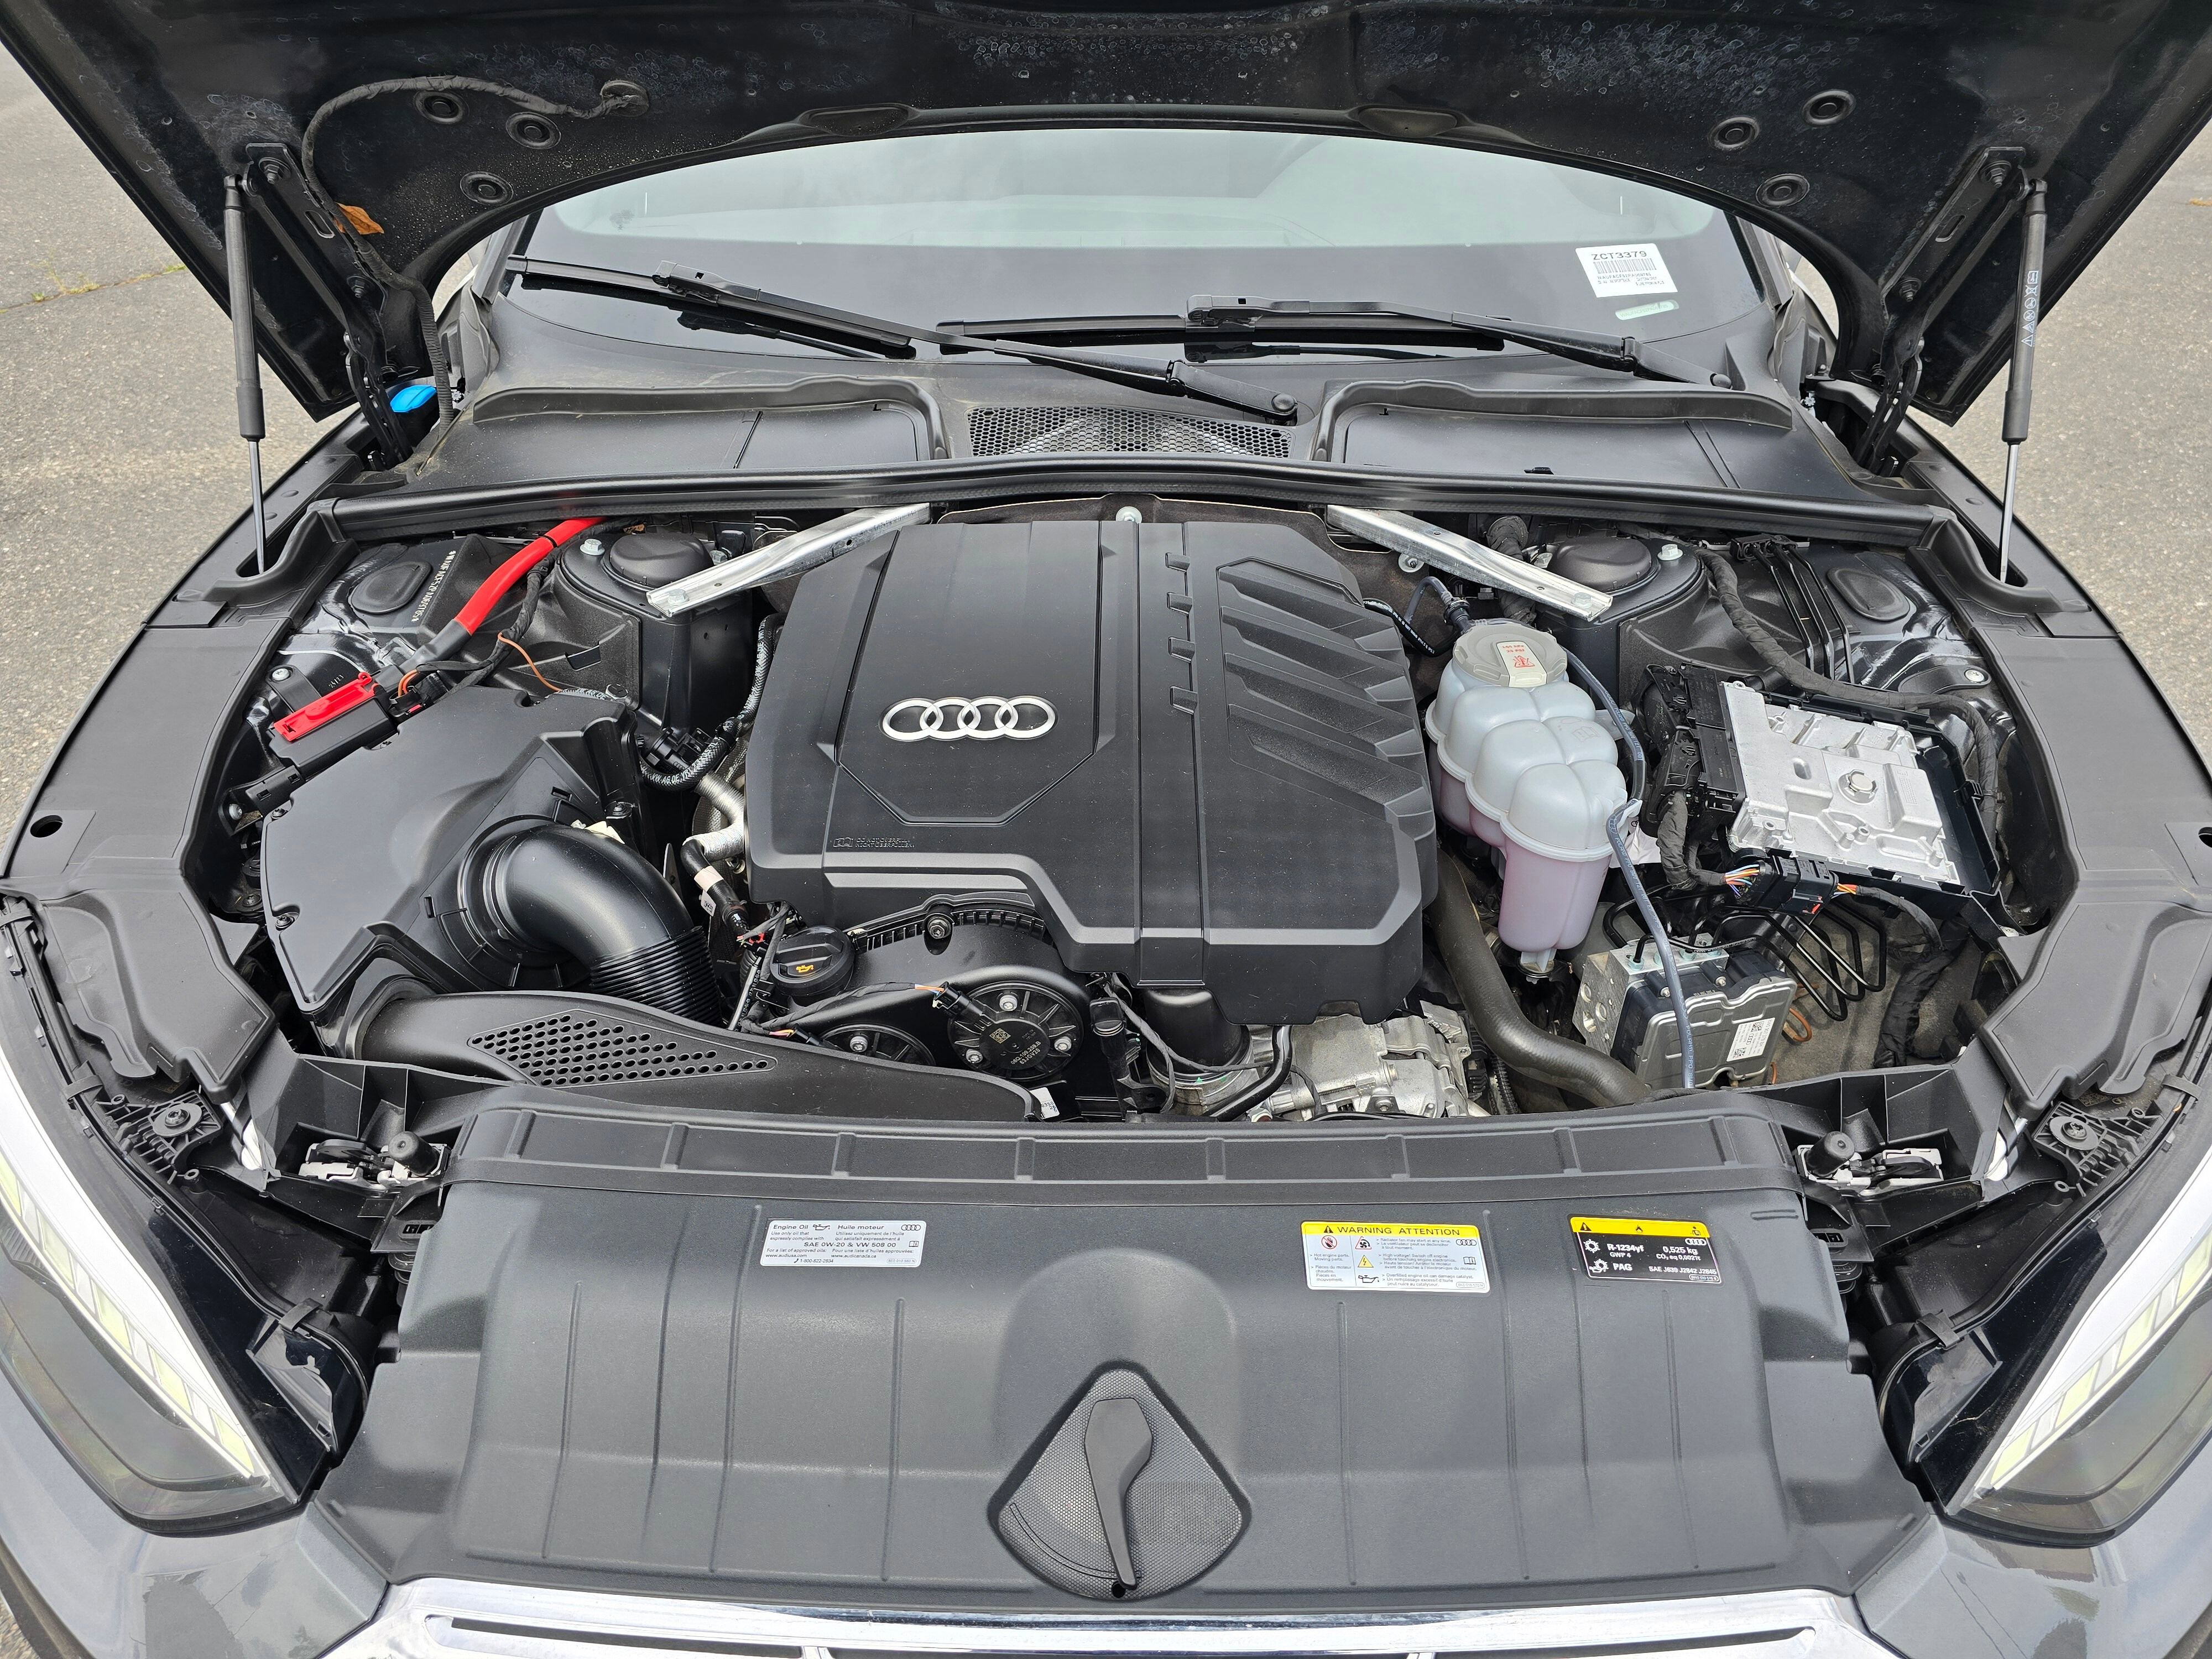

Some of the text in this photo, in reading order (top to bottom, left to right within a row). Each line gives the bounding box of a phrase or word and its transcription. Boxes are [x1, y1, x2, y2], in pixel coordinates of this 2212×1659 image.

[1591, 251, 1647, 260] ZCT3379
[1607, 1243, 1645, 1253] R-1234yf
[1686, 1247, 1698, 1255] kg
[1613, 1262, 1632, 1271] PAG
